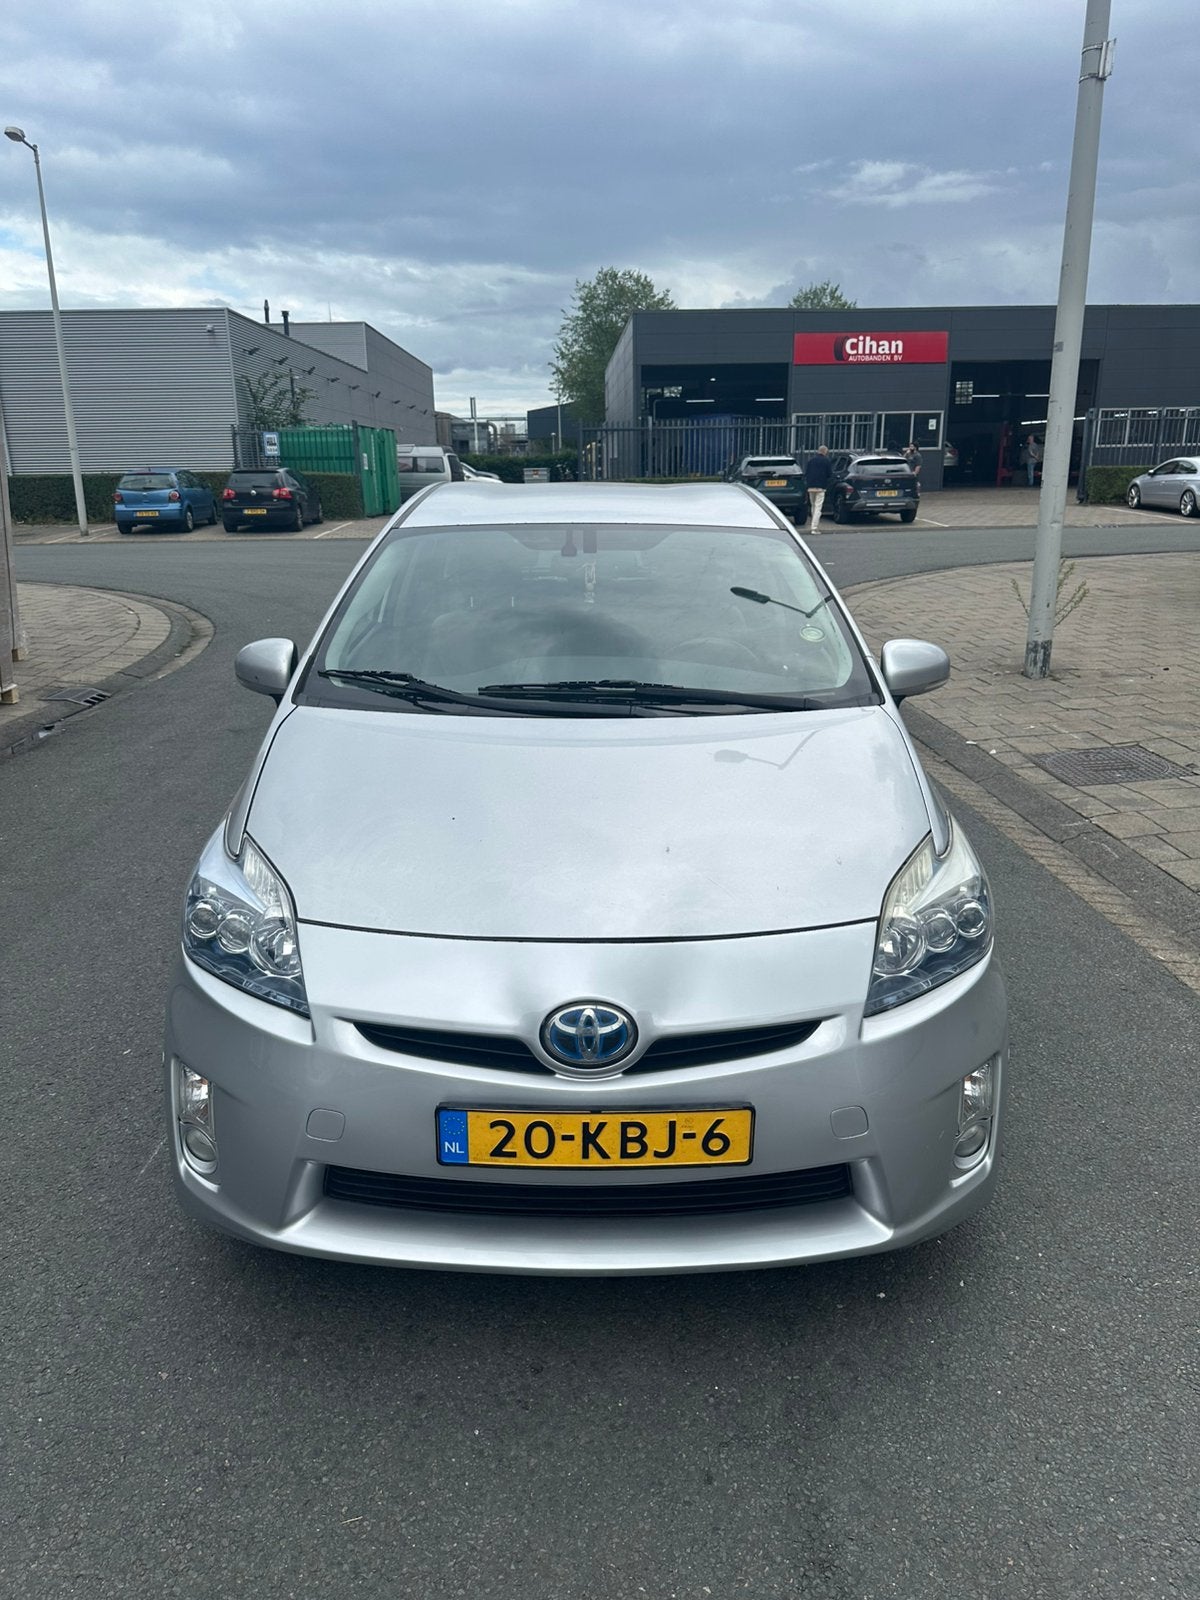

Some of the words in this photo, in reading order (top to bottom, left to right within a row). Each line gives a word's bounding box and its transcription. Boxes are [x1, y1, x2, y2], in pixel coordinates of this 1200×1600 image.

[845, 335, 903, 355] Cihan
[444, 1141, 465, 1154] NL
[489, 1118, 731, 1159] 20-KBJ-6
